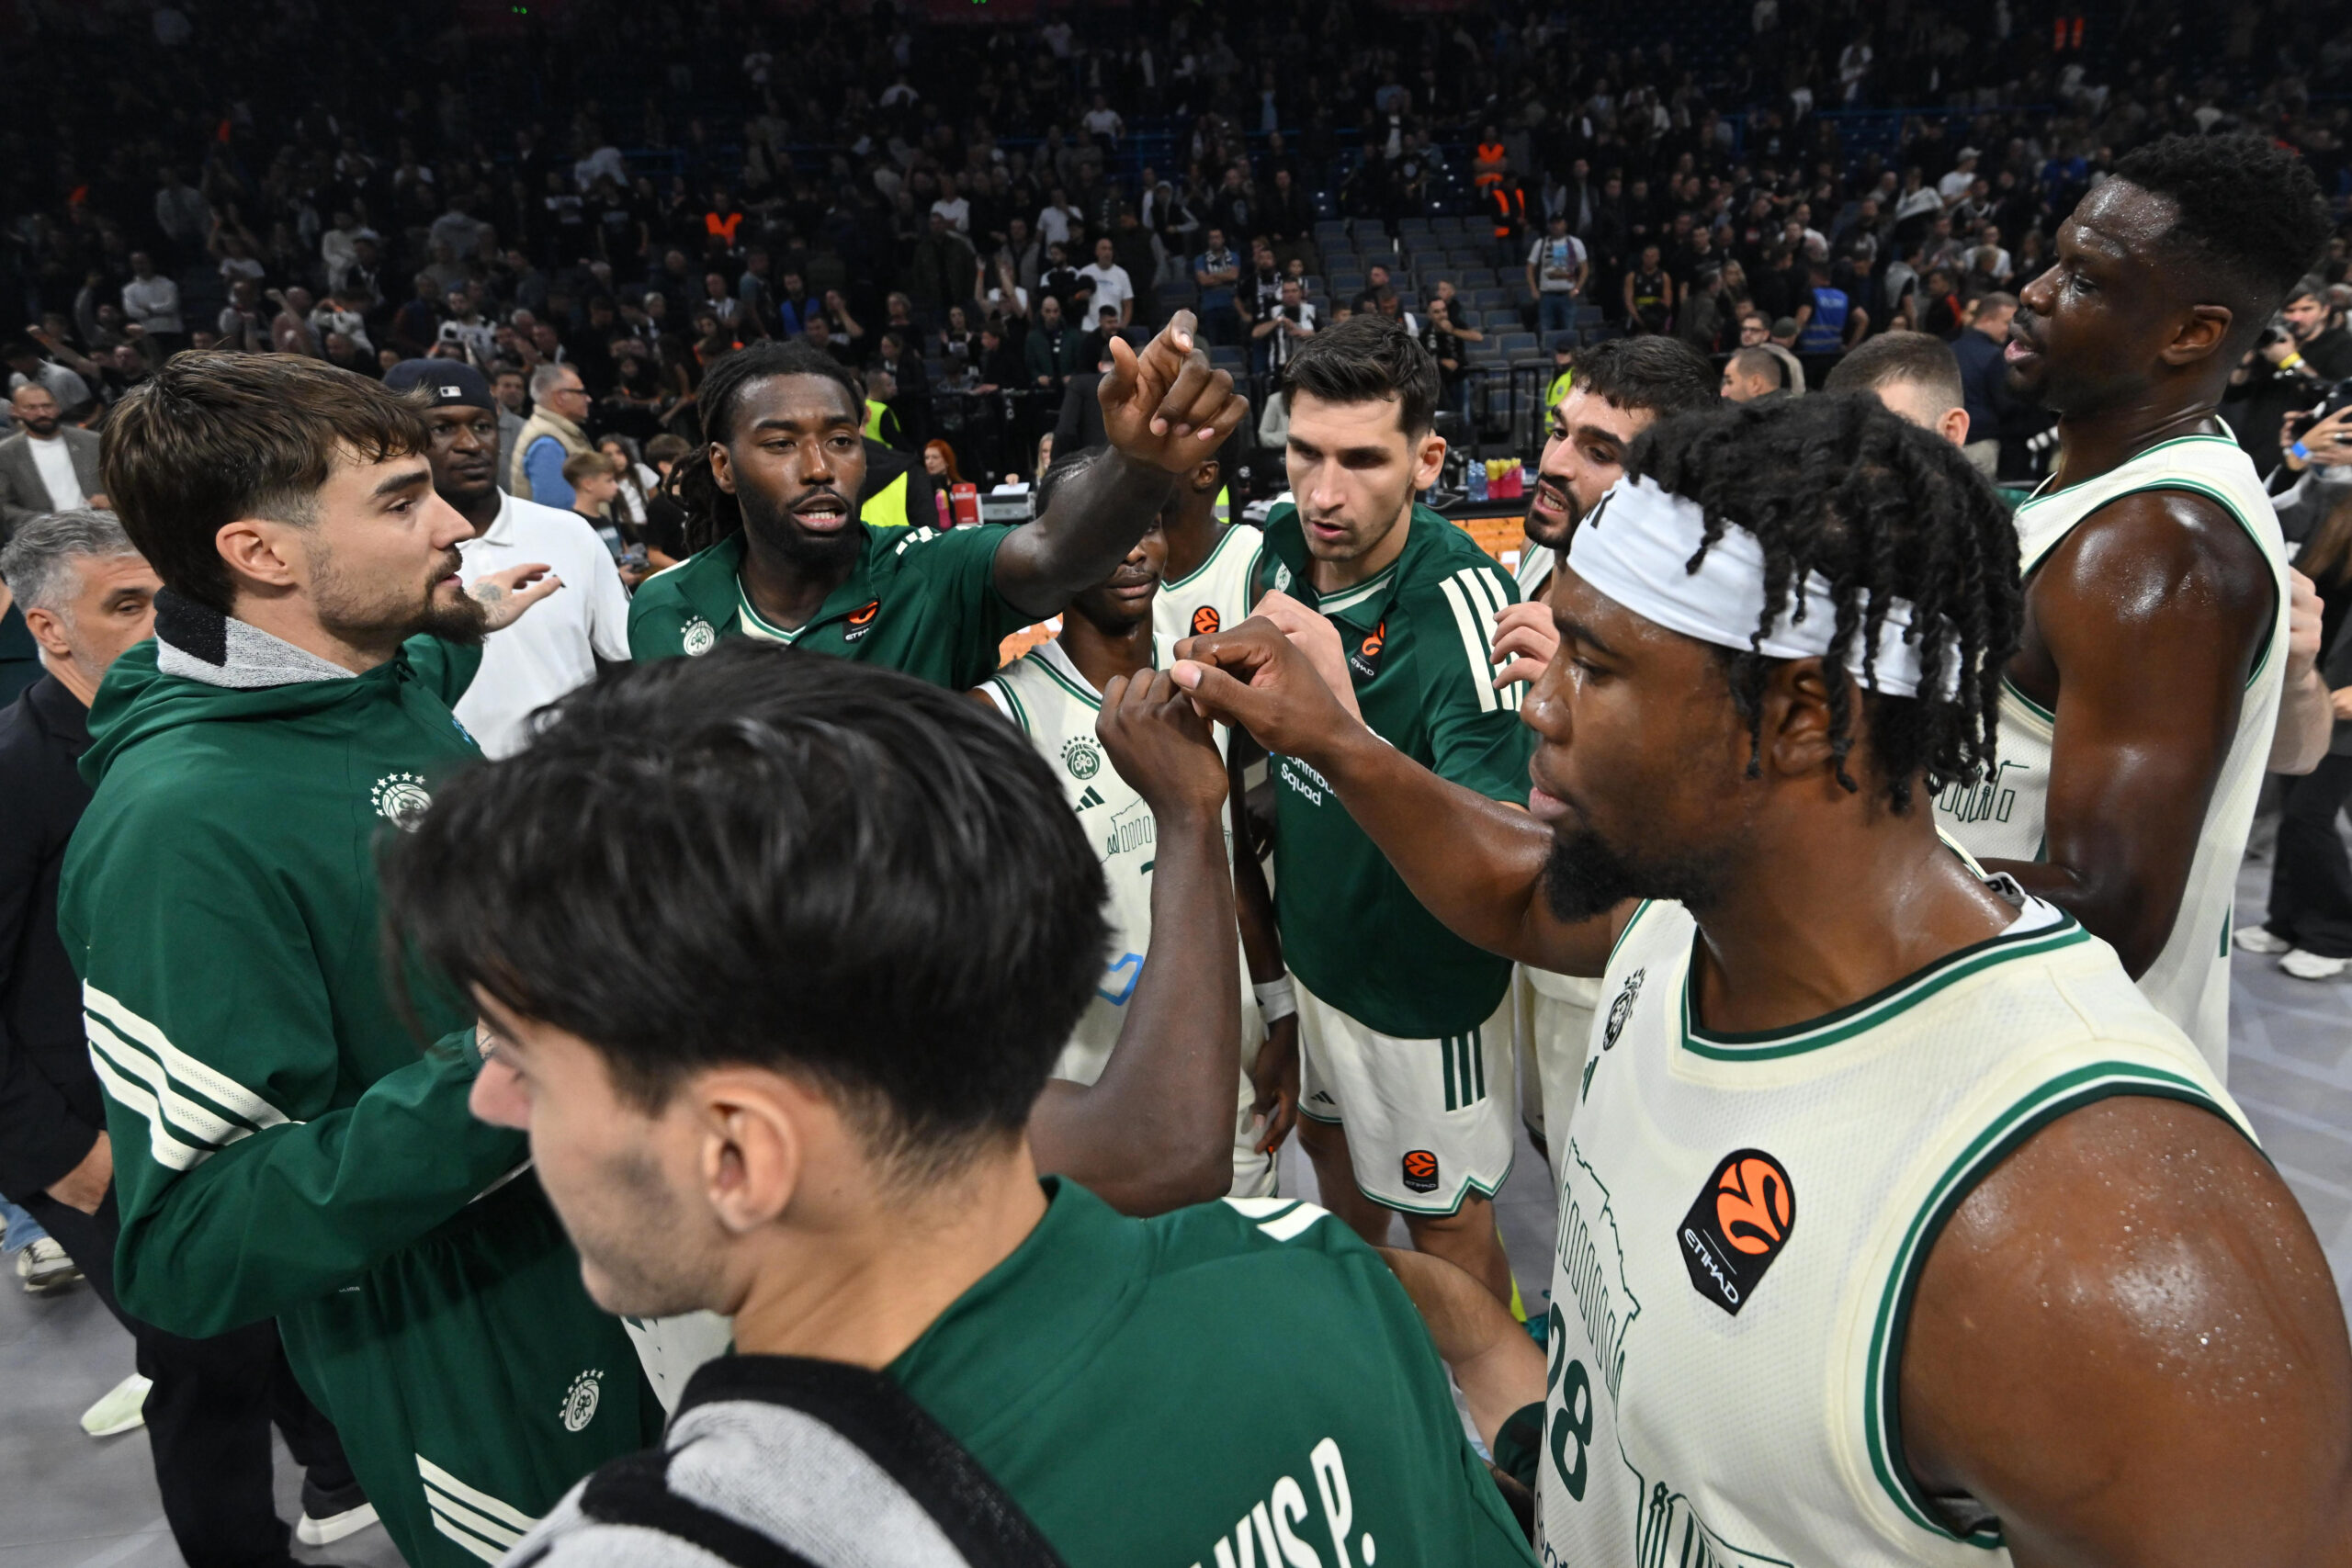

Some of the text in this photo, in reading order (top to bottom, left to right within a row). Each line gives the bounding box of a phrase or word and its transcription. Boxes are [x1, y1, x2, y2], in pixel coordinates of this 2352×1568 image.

[1281, 762, 1321, 807] Squad
[1684, 1228, 1739, 1304] ETIHAD
[1544, 1302, 1593, 1502] 28
